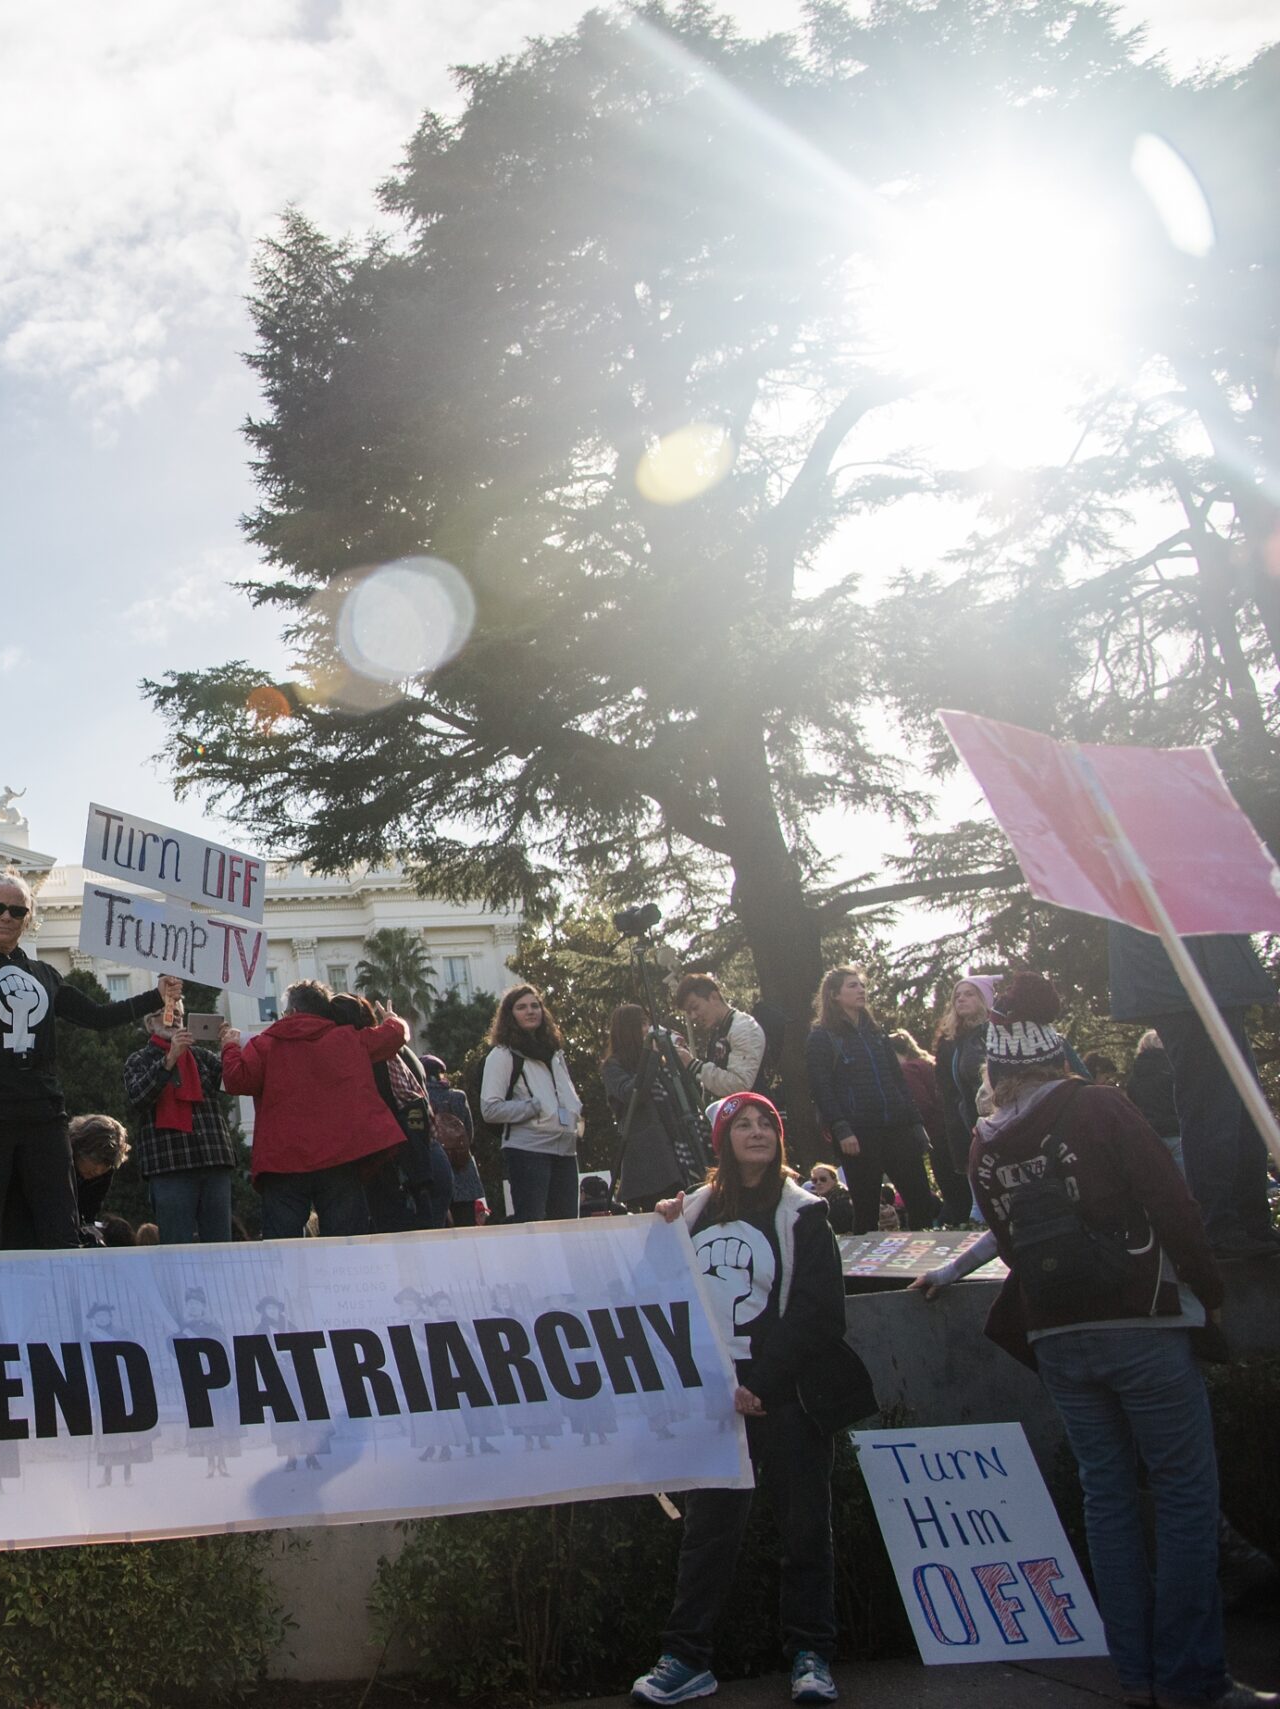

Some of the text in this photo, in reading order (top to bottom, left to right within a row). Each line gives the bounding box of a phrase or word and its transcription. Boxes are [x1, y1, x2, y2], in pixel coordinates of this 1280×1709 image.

[95, 809, 260, 908] Turn OFF
[94, 890, 262, 987] Trump TV
[337, 1299, 375, 1311] MUST
[355, 1281, 387, 1293] LONG
[172, 1301, 703, 1429] PATRIARCHY
[913, 1557, 1084, 1646] OFF
